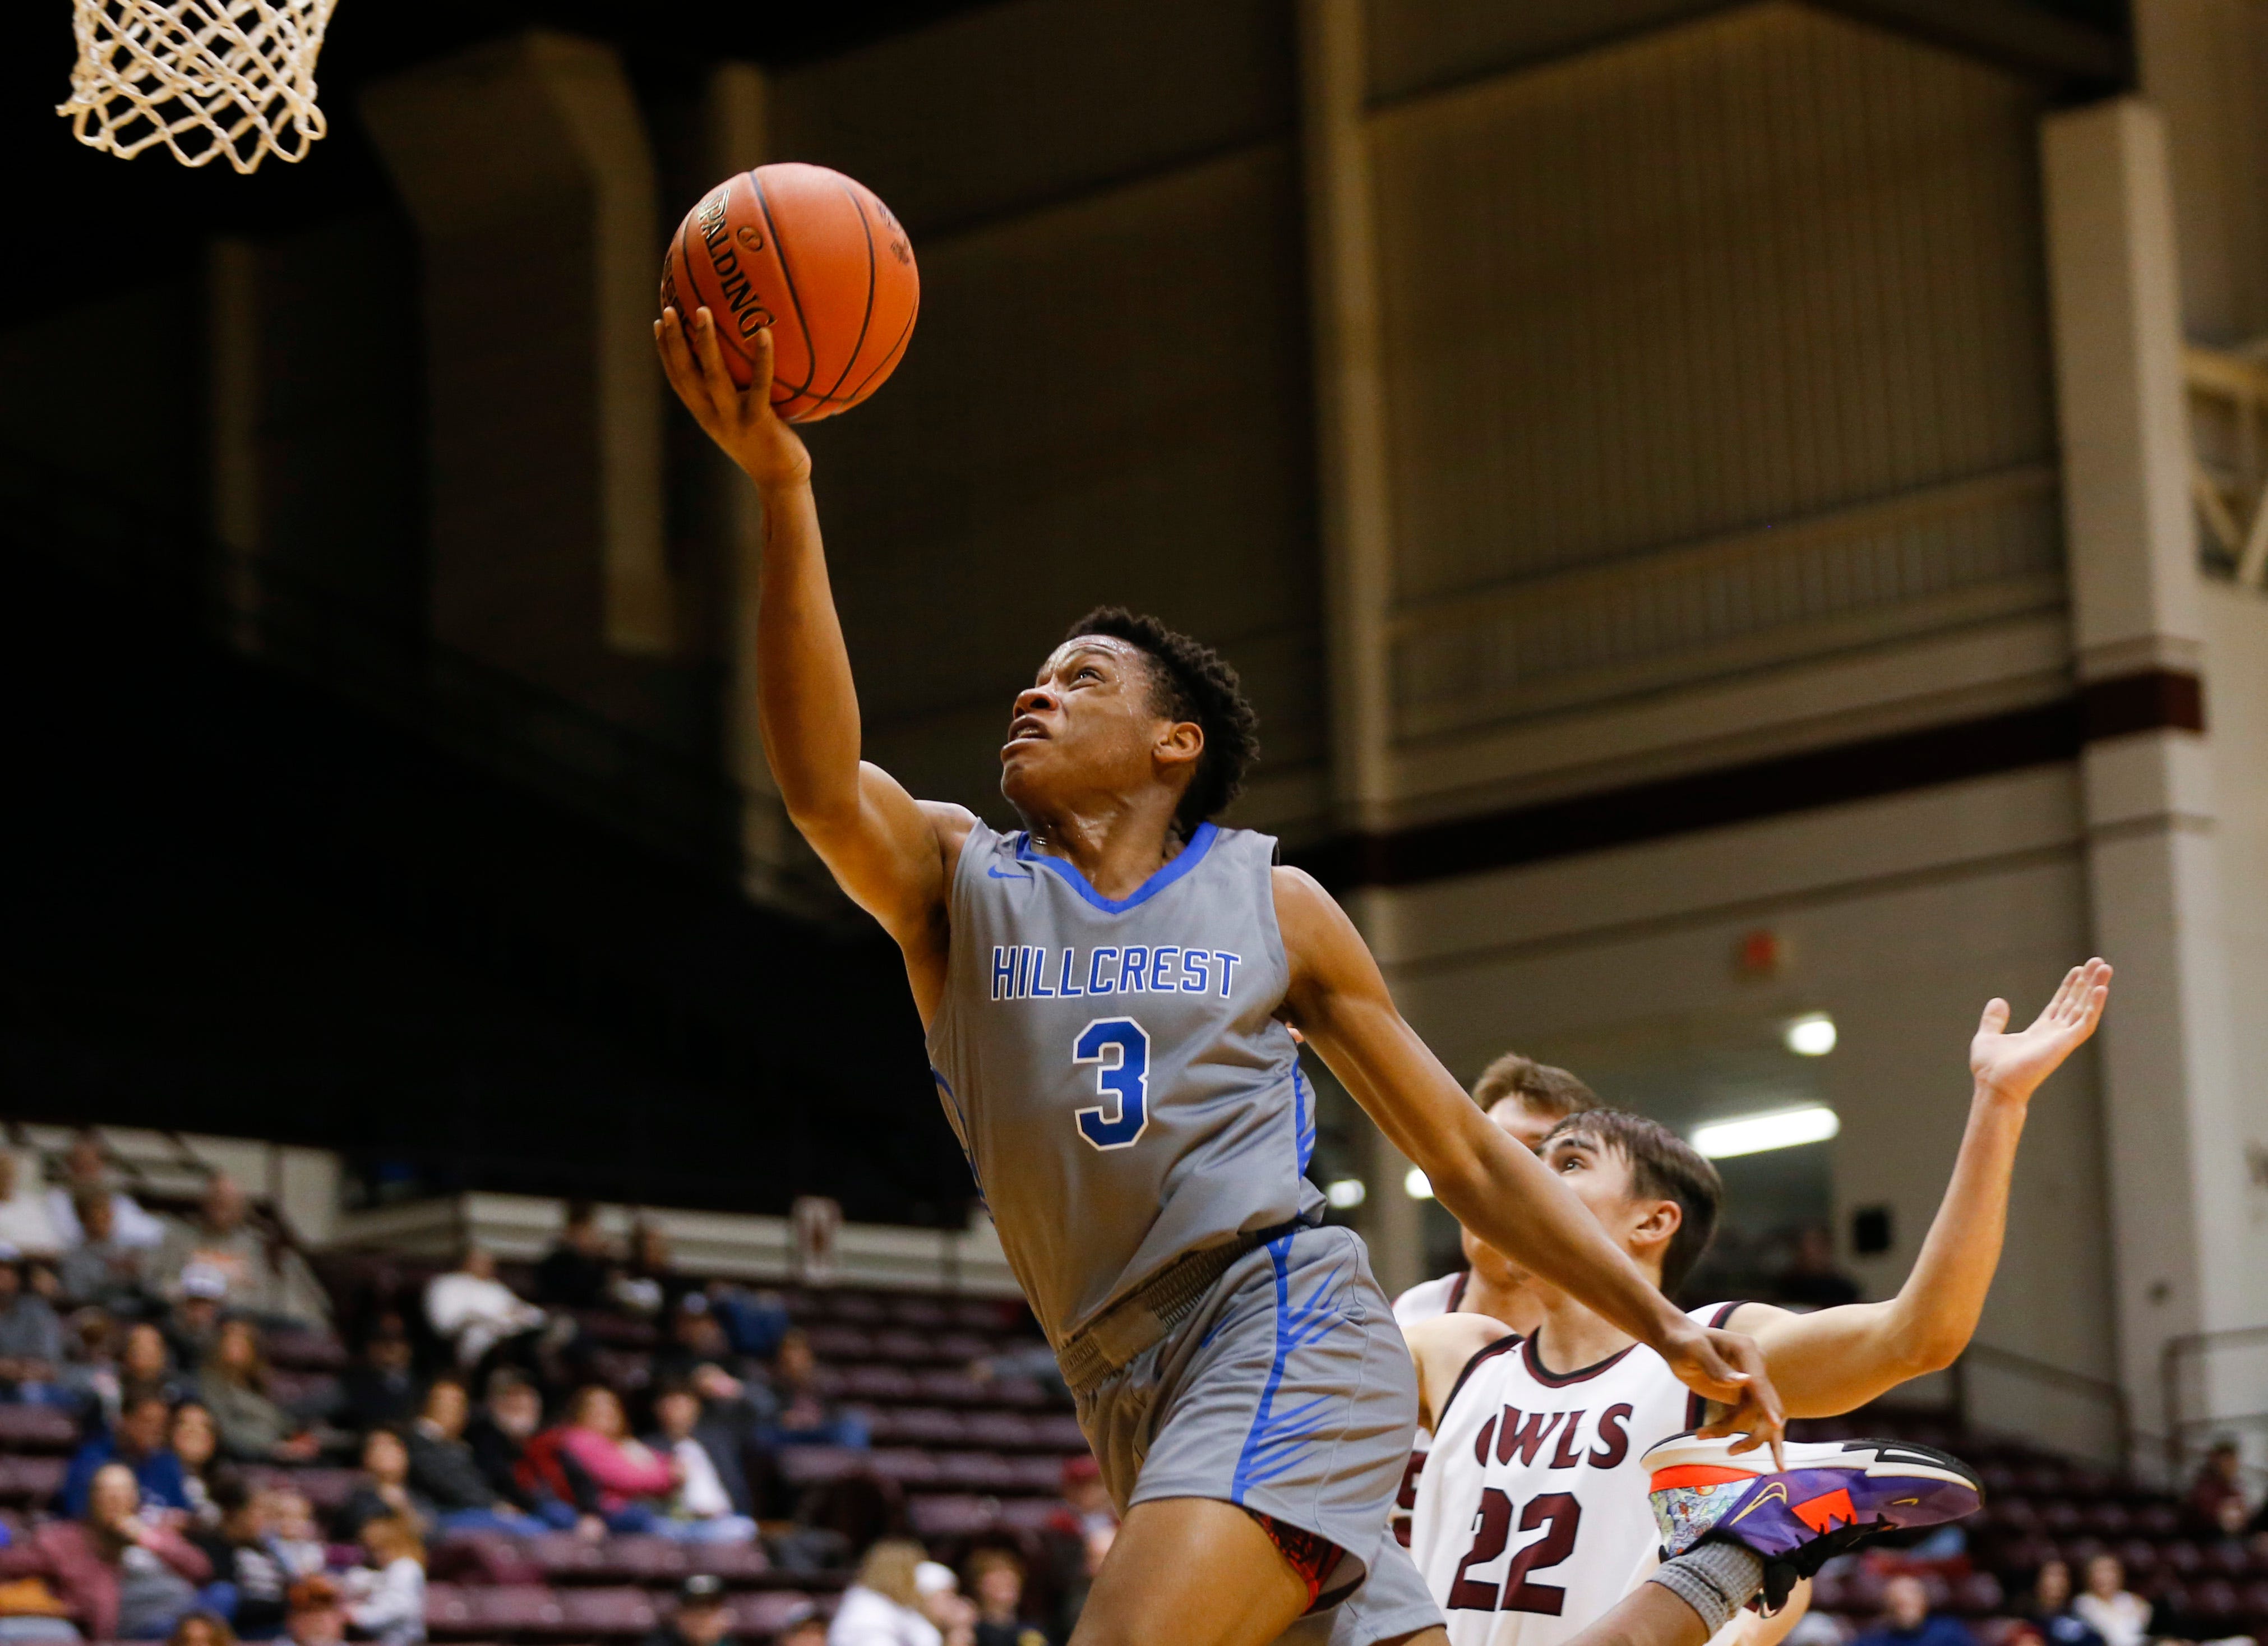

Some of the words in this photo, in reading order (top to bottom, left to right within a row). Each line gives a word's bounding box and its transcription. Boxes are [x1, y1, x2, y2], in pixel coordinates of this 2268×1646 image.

[992, 945, 1241, 1000] HILLCREST
[1073, 1016, 1151, 1151] 3
[1447, 1487, 1582, 1616] 22
